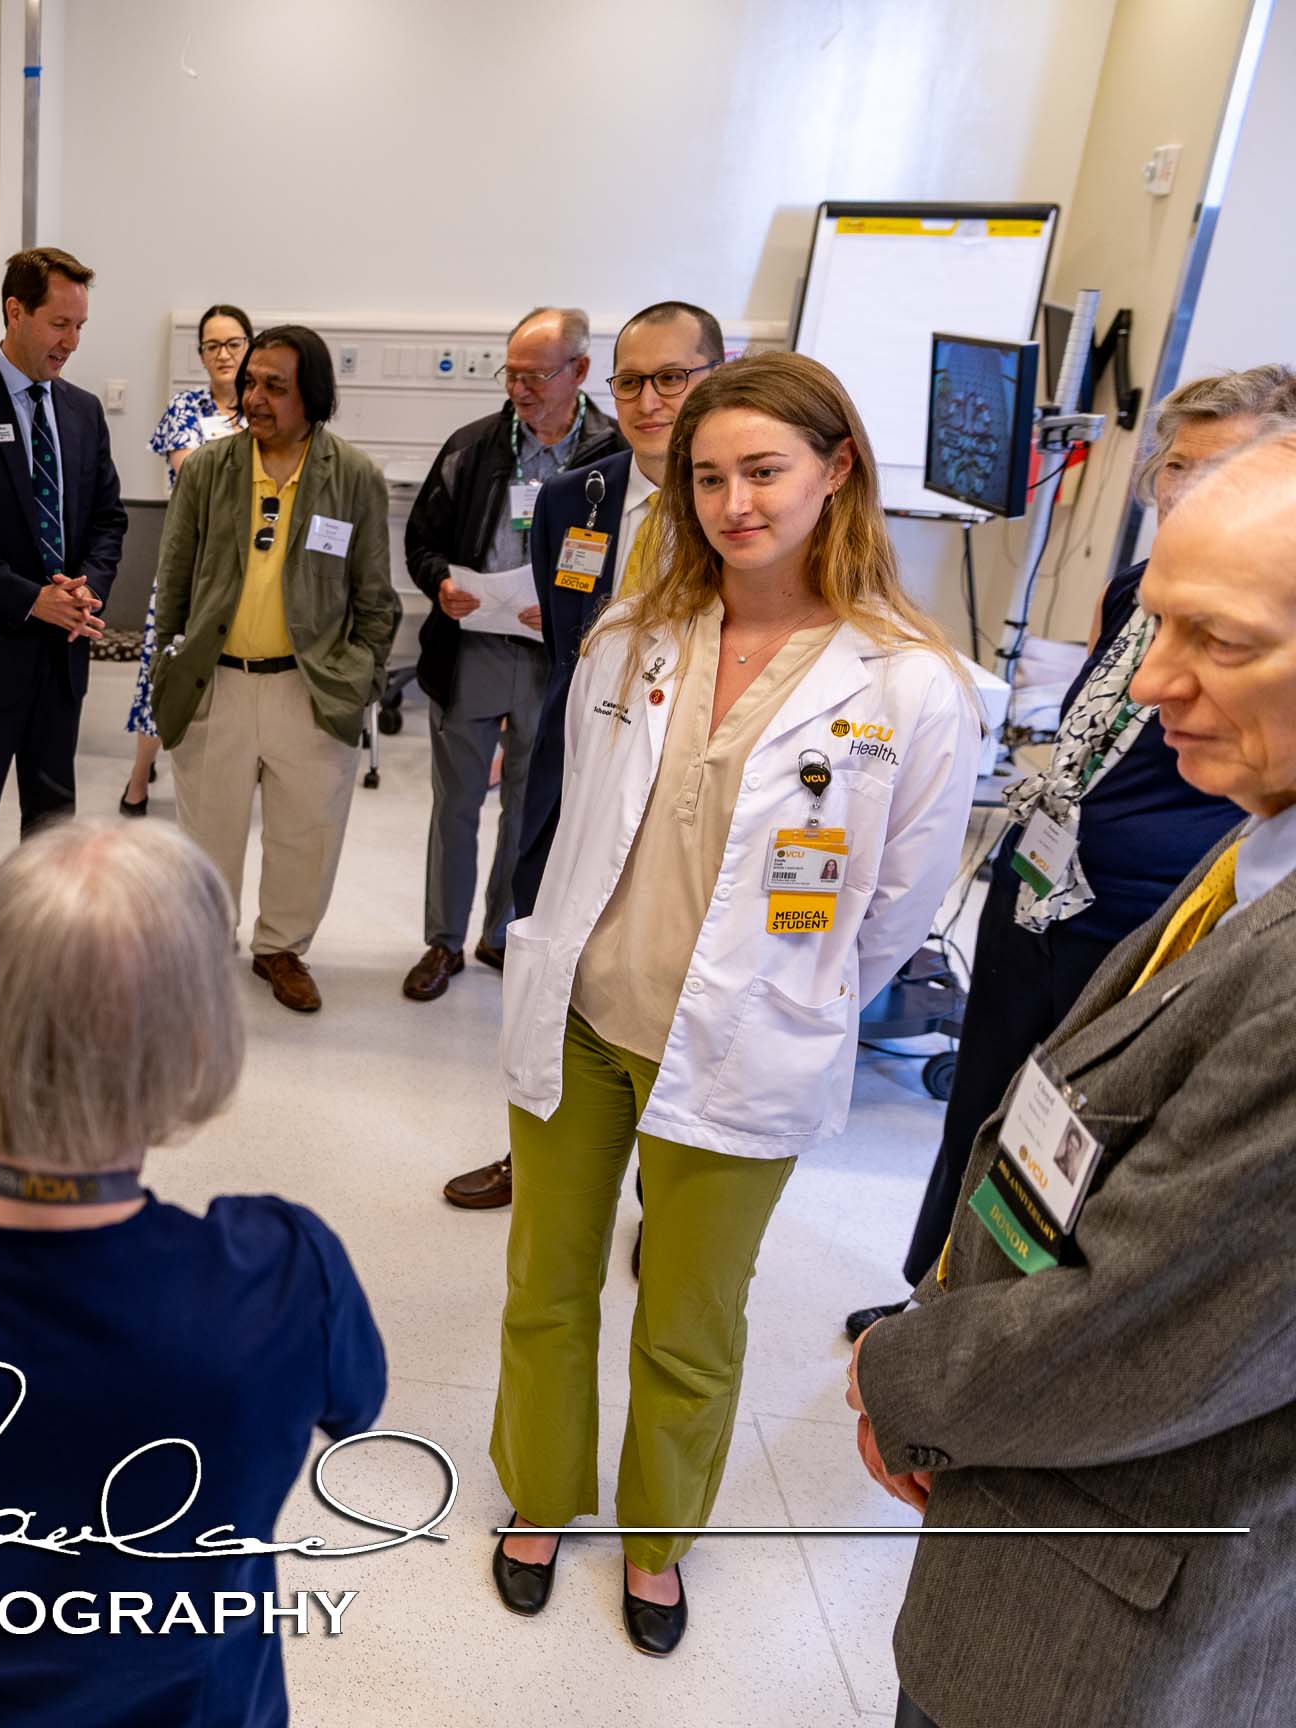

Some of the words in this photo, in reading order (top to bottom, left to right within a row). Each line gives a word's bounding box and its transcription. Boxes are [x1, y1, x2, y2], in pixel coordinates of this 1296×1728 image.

[851, 722, 894, 742] VCU
[849, 740, 897, 765] Health
[803, 774, 826, 783] VCU
[786, 850, 805, 858] VCU
[775, 910, 828, 921] MEDICAL
[772, 919, 829, 930] STUDENT
[1027, 1156, 1050, 1190] VCU
[989, 1204, 1030, 1260] DONOR
